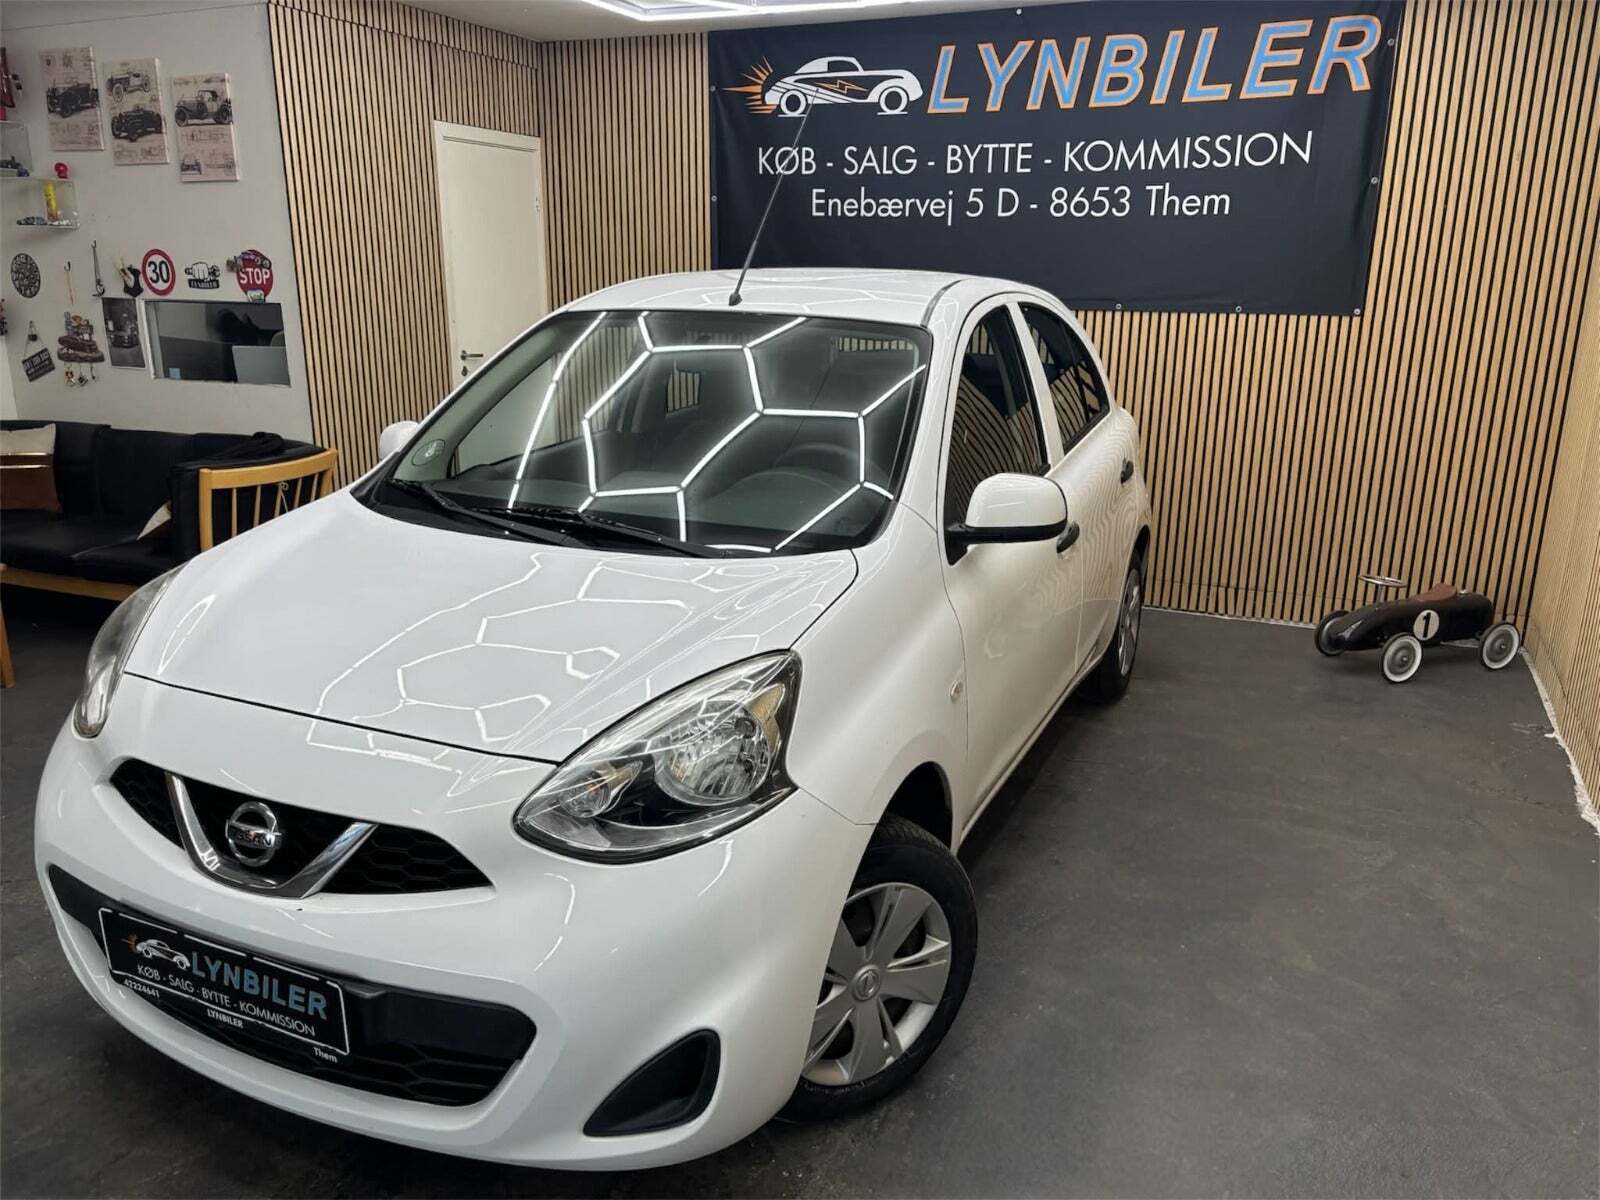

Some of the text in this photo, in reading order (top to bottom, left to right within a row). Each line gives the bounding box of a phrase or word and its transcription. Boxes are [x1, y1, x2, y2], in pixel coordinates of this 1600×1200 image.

[927, 14, 1382, 114] LYNBILER
[758, 146, 817, 175] KØB
[843, 145, 918, 176] SALG
[946, 142, 1033, 174] BYTTE
[1063, 130, 1313, 172] KOMMISSION
[811, 186, 954, 227] Enebærvej
[965, 187, 984, 218] 5
[997, 187, 1020, 217] D
[1049, 185, 1131, 218] 8653
[1145, 182, 1231, 217] Them
[148, 260, 170, 284] 30
[240, 267, 270, 285] STOP
[1422, 612, 1431, 638] 1
[137, 964, 161, 981] KØB
[168, 974, 195, 993] SALG
[201, 986, 230, 1008] BYTTE
[239, 1000, 316, 1037] KOMMISSION
[192, 951, 327, 1020] LYNBILER
[206, 1008, 244, 1029] LYNBILER
[313, 1046, 338, 1063] Them
